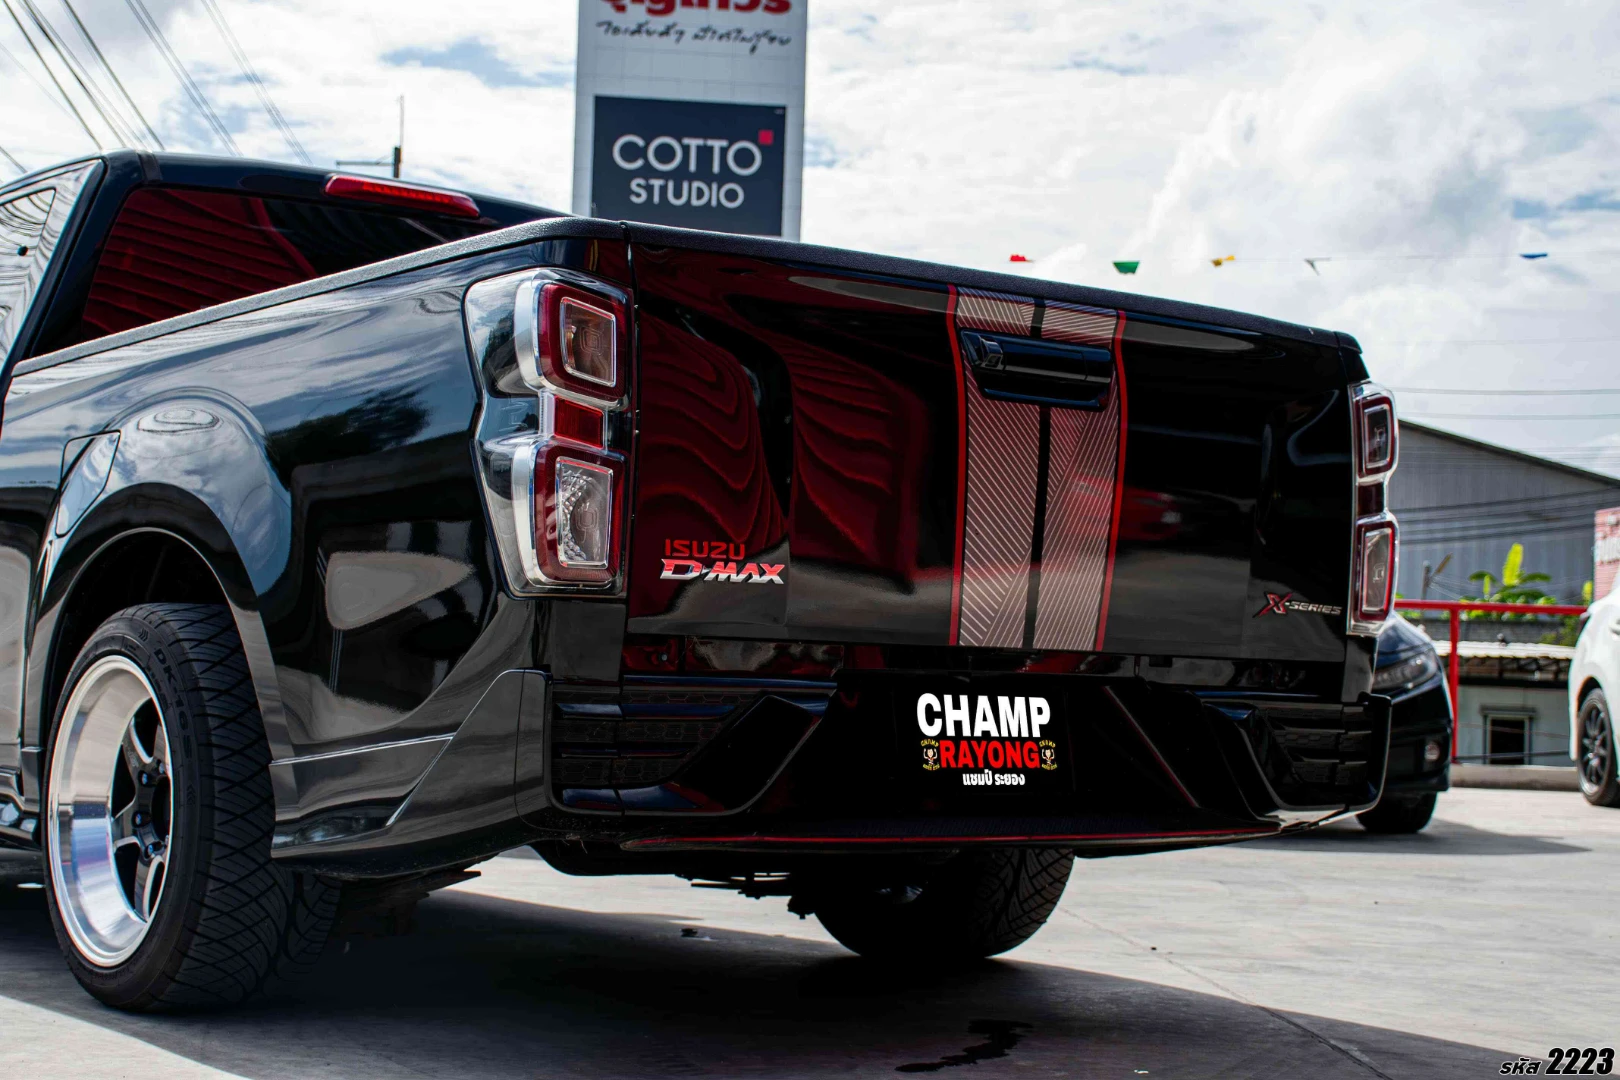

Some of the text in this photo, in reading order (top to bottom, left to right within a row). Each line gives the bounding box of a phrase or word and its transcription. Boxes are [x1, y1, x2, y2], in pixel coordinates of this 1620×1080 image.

[612, 134, 762, 176] COTTO
[629, 177, 745, 209] STUDIO
[664, 538, 745, 560] ISUZU
[660, 558, 785, 584] D-MAX
[1253, 591, 1342, 617] X-SERIES
[916, 692, 1051, 738] CHAMP
[939, 739, 1041, 769] RAYONG
[994, 773, 1026, 786] ระยอง
